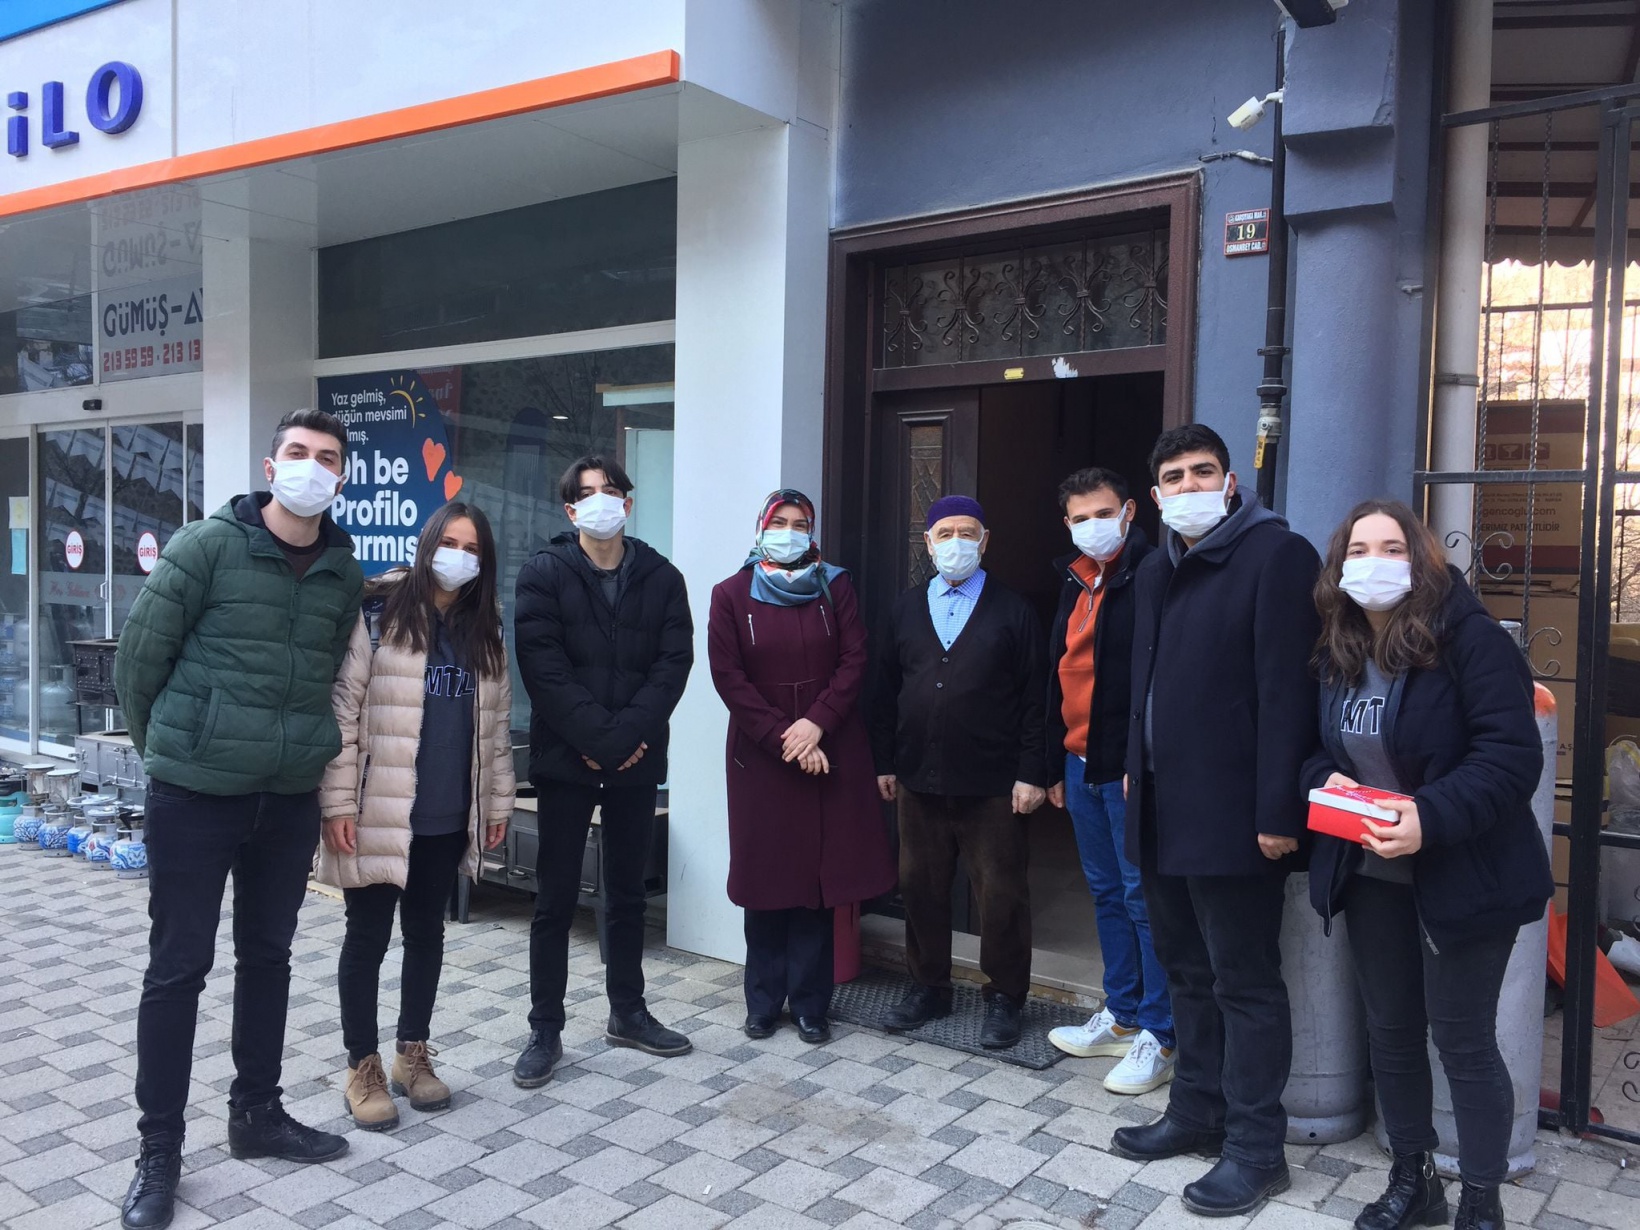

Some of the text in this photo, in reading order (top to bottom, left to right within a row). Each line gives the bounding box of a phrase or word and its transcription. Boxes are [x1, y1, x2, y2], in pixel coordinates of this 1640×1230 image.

[1237, 223, 1256, 241] 19
[103, 288, 203, 338] GÜMÜŞ-A
[104, 350, 122, 372] 213
[125, 348, 138, 369] 59
[140, 346, 154, 367] 59
[163, 341, 184, 365] 213
[331, 388, 387, 407] Yaz gelmiş,
[364, 405, 407, 422] mevsimi
[346, 428, 369, 445] lmış.
[374, 450, 409, 485] be
[331, 490, 418, 527] Profilo
[67, 542, 82, 556] GİRİŞ
[139, 544, 157, 560] GİRİŞ
